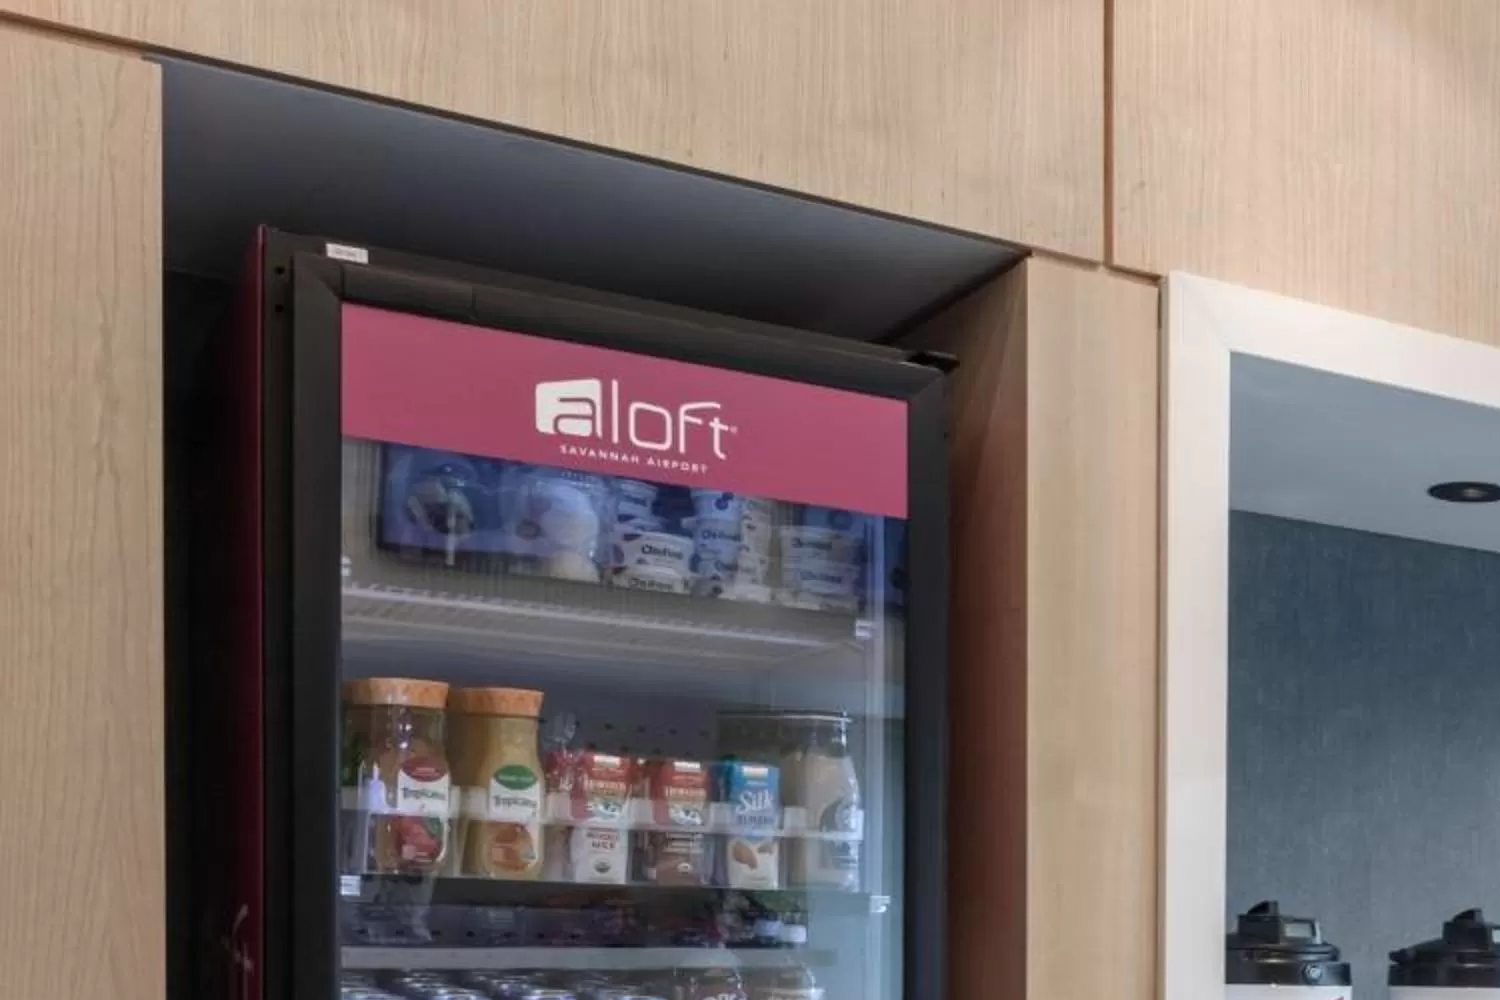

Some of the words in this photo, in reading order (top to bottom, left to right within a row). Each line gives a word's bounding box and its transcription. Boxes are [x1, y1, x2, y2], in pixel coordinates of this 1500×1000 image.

[535, 378, 732, 461] aloft
[559, 444, 640, 466] SAVANNAH
[646, 456, 708, 475] AIRPORT
[736, 789, 773, 814] Silk
